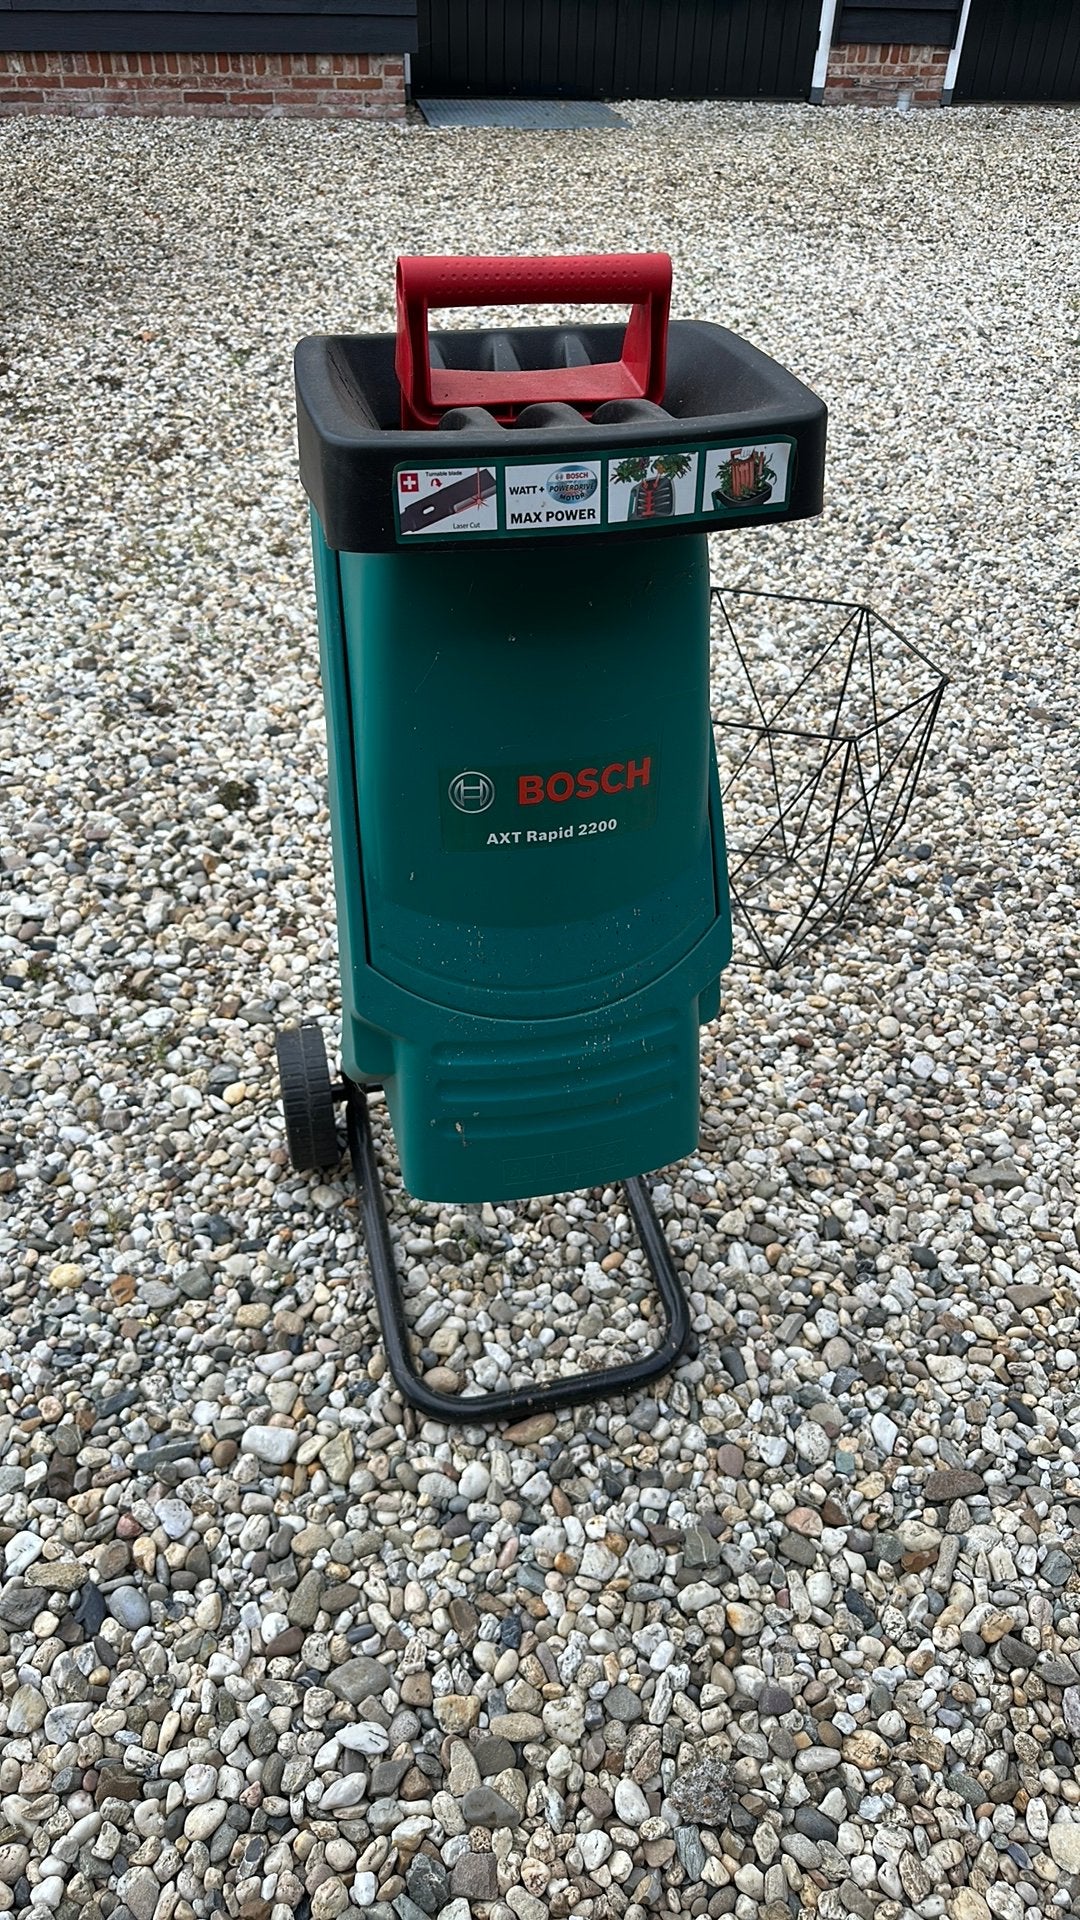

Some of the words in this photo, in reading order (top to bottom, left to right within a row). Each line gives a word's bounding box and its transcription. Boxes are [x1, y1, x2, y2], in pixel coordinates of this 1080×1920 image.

[509, 485, 537, 495] WATT
[549, 483, 594, 493] POWERDRIVE
[559, 493, 585, 501] MOTOR
[510, 511, 542, 524] MAX
[546, 508, 596, 522] POWER
[518, 756, 652, 806] BOSCH
[486, 831, 522, 845] AXT
[527, 825, 574, 843] Rapid
[578, 818, 618, 836] 2200
